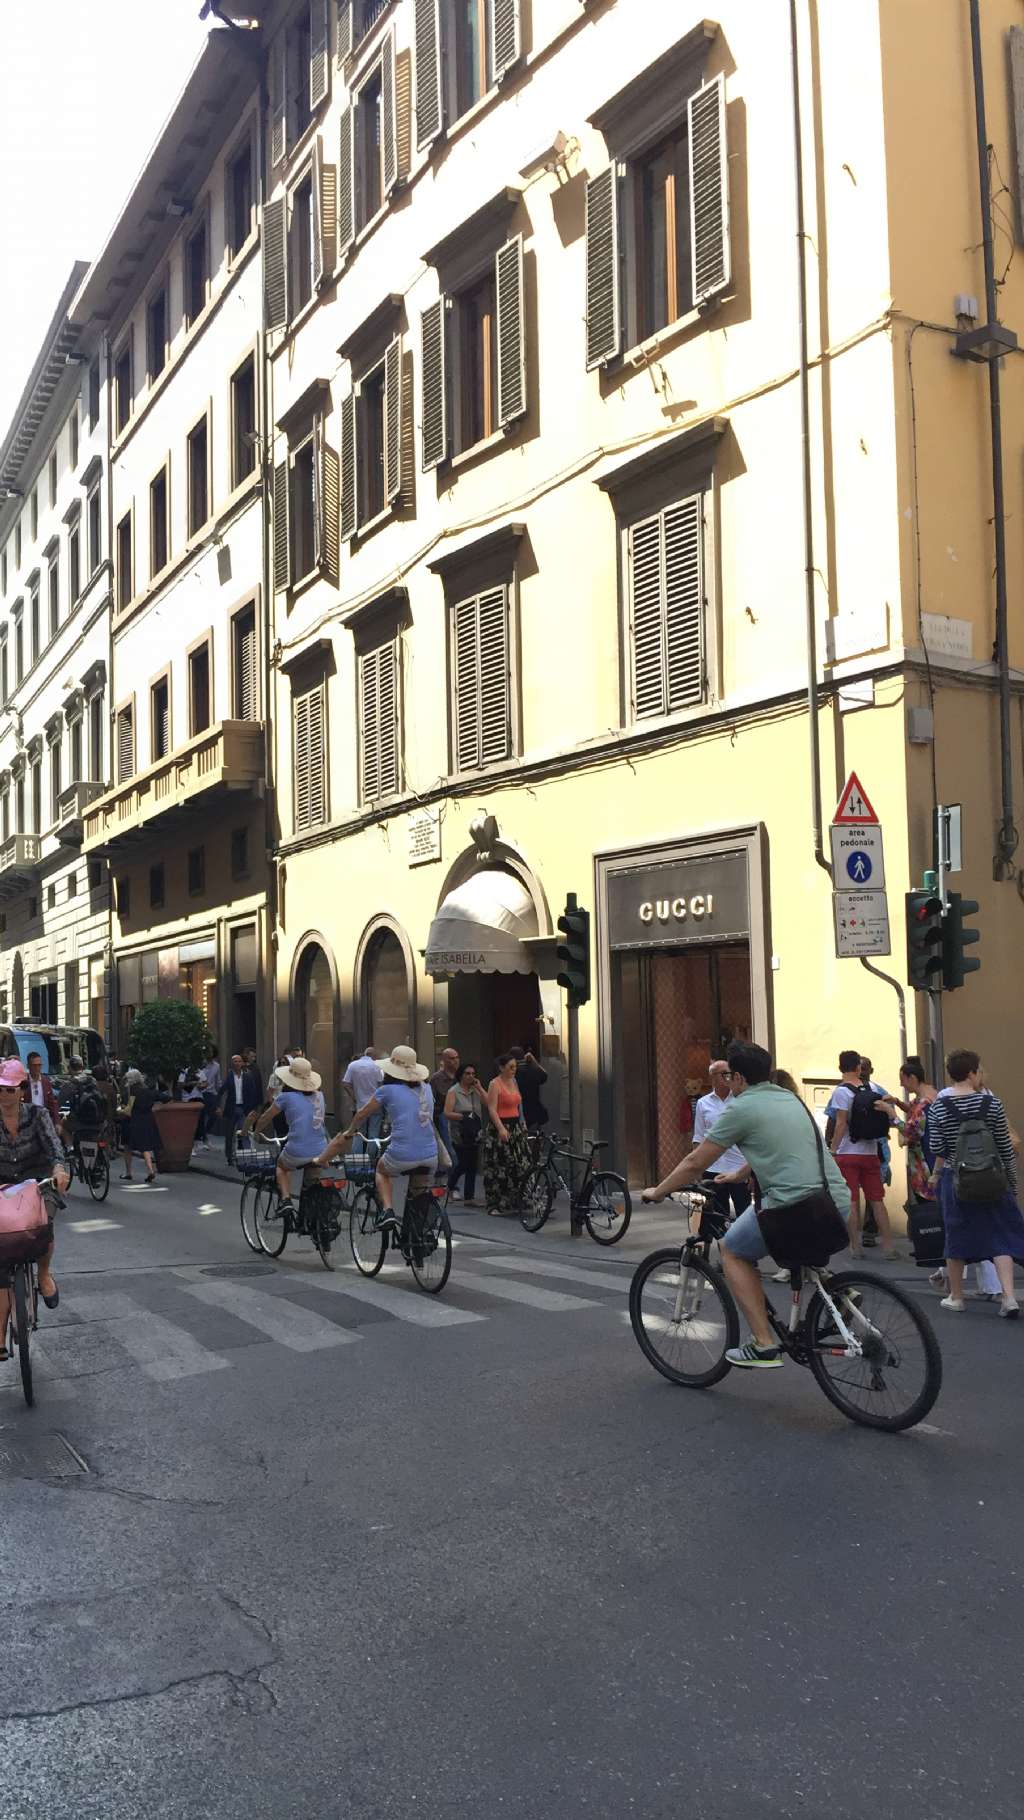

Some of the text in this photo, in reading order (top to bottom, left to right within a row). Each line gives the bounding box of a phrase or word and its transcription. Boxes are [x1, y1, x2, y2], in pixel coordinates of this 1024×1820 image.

[840, 838, 875, 847] pedonale
[639, 894, 713, 921] GUCCI
[441, 951, 486, 965] ISABELLA
